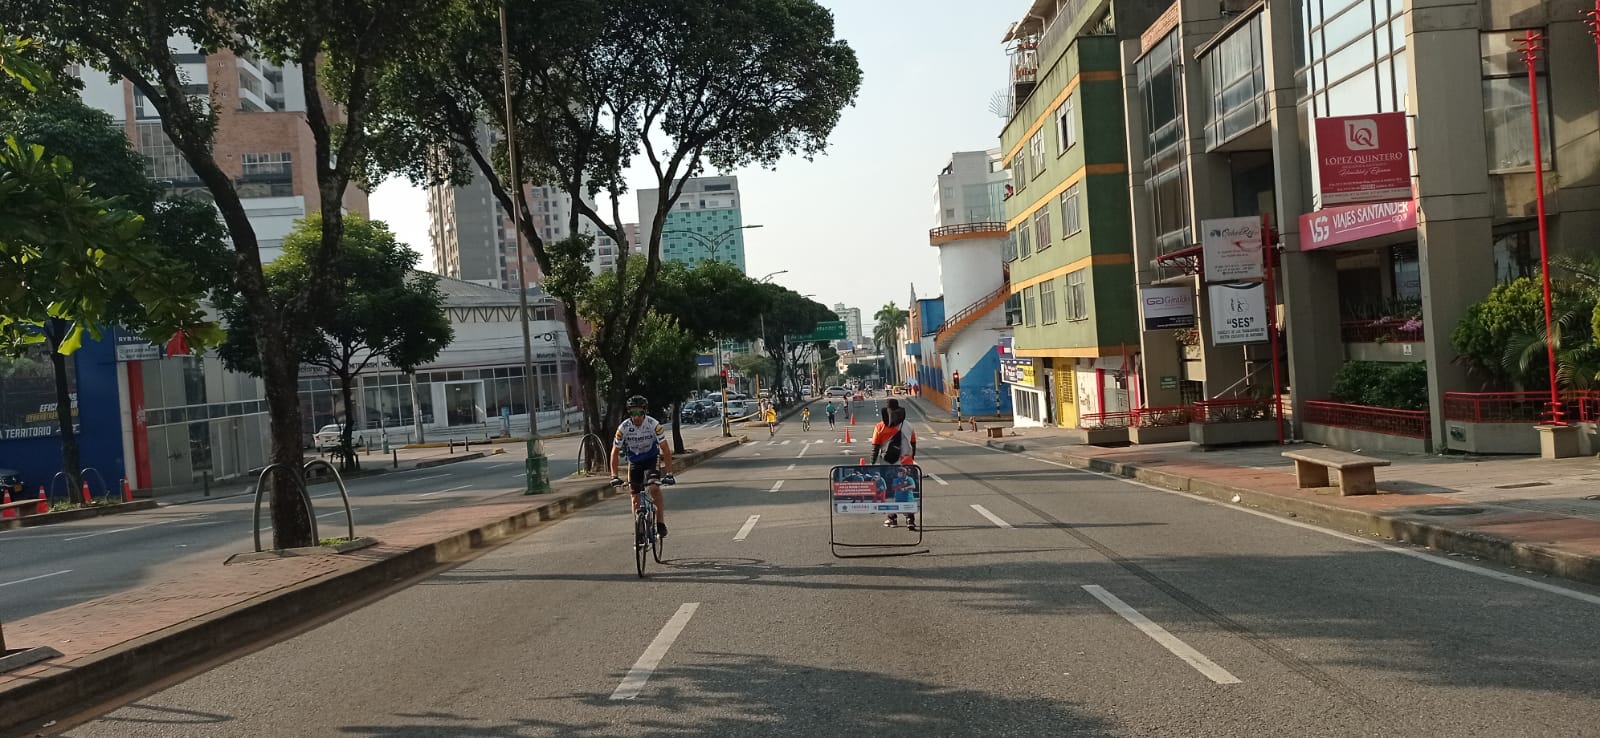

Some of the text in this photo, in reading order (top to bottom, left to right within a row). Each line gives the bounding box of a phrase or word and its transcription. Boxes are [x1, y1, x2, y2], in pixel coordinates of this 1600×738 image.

[1354, 151, 1403, 164] QUINTERO
[1332, 201, 1409, 229] VIAJES SANTANDER
[4, 425, 51, 438] TERRITORIO
